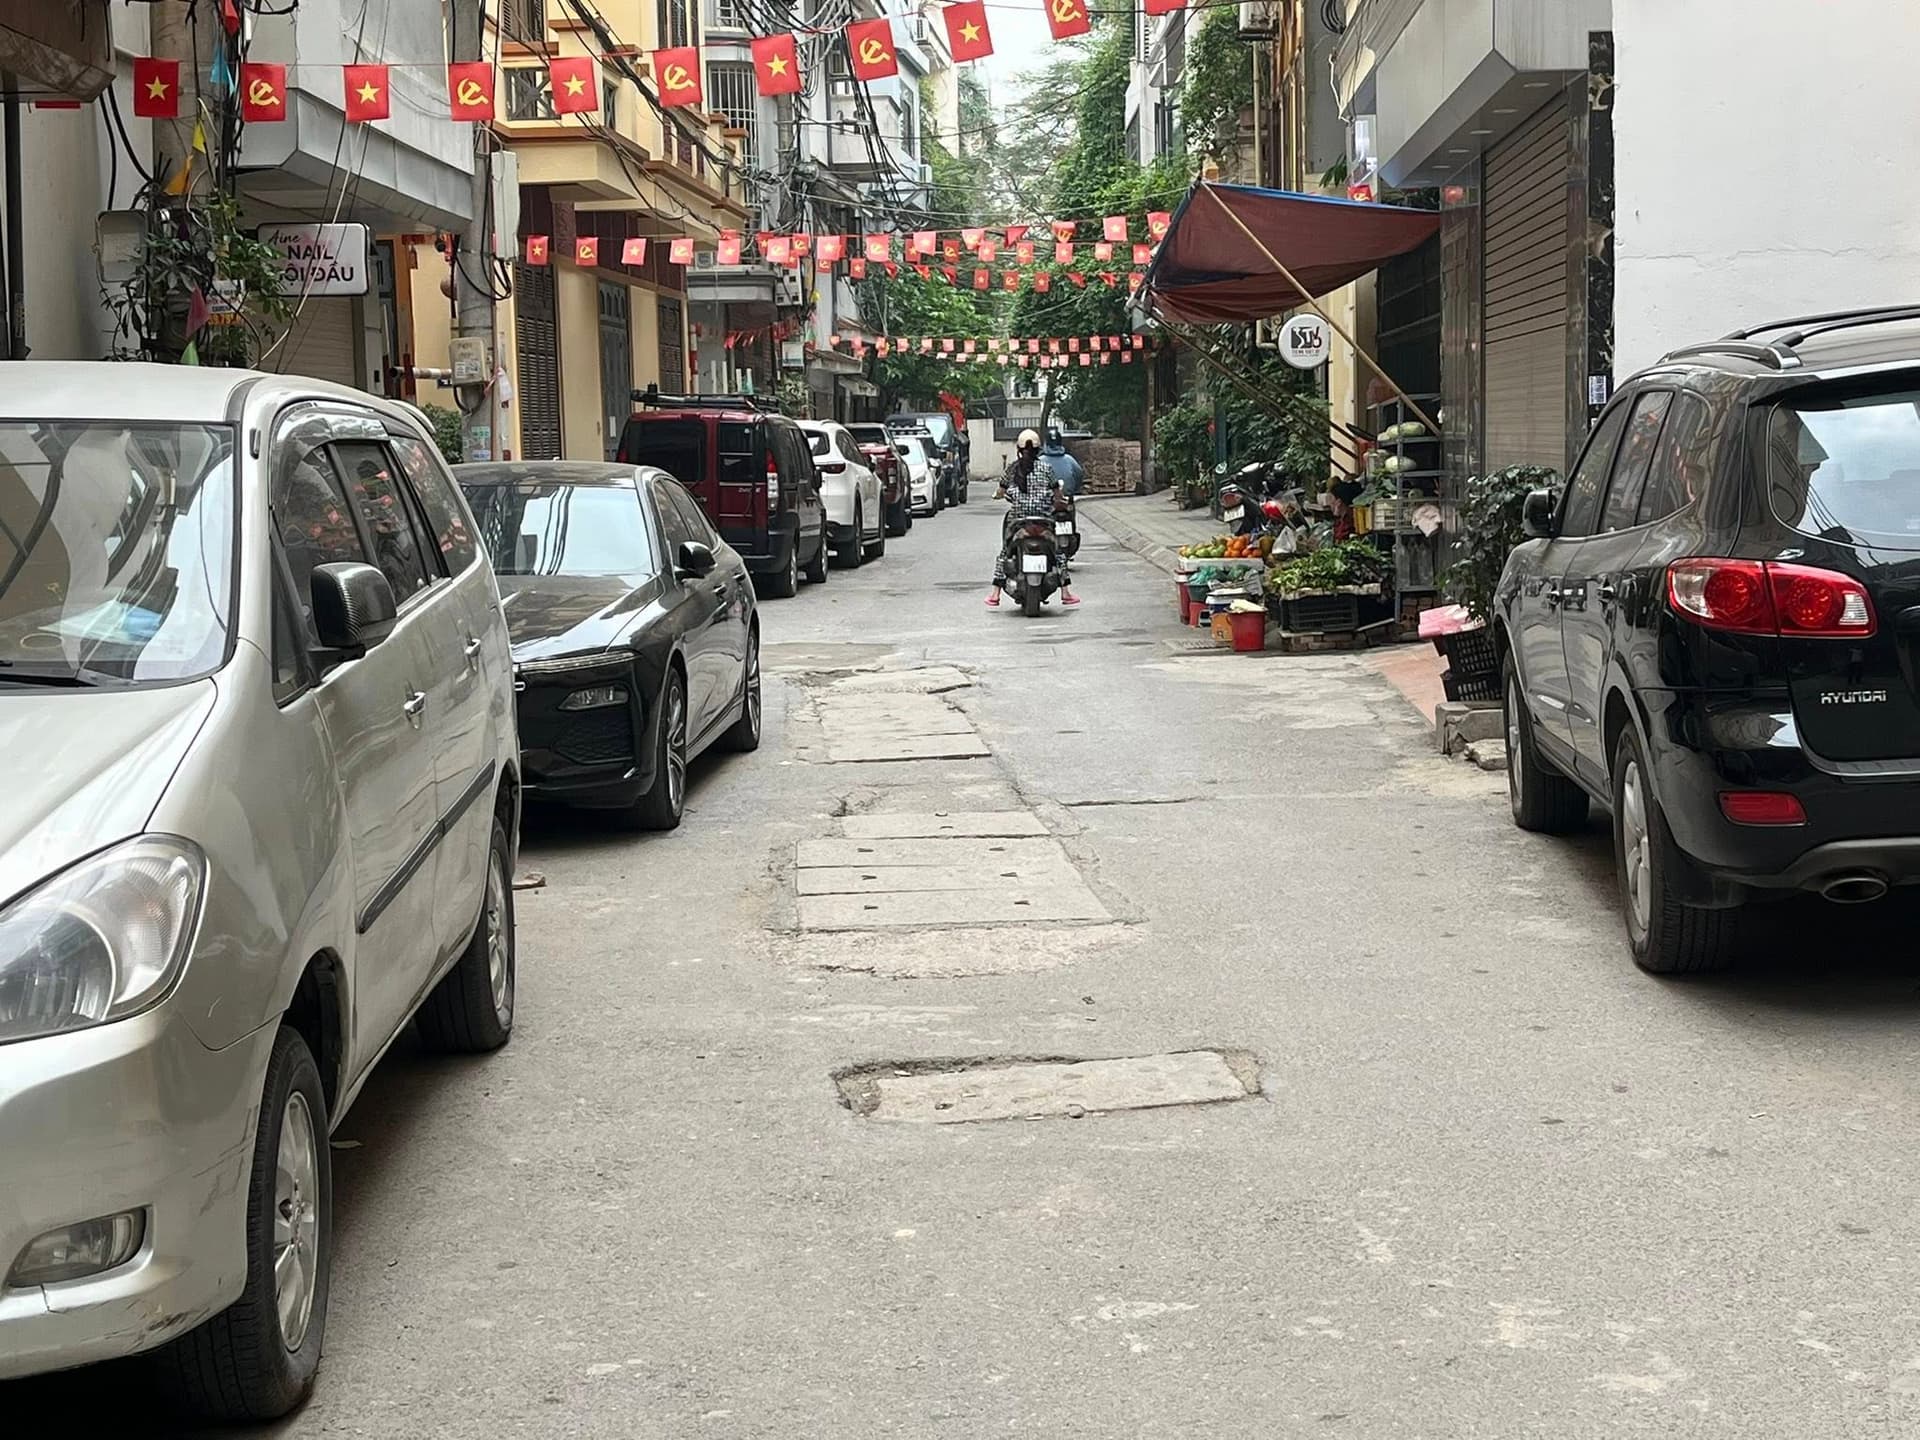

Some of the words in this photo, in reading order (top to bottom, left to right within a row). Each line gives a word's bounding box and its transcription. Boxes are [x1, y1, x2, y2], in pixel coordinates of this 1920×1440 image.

[287, 244, 334, 260] NAIL
[279, 263, 305, 286] ỘI
[1820, 690, 1887, 704] HYUNDAI
